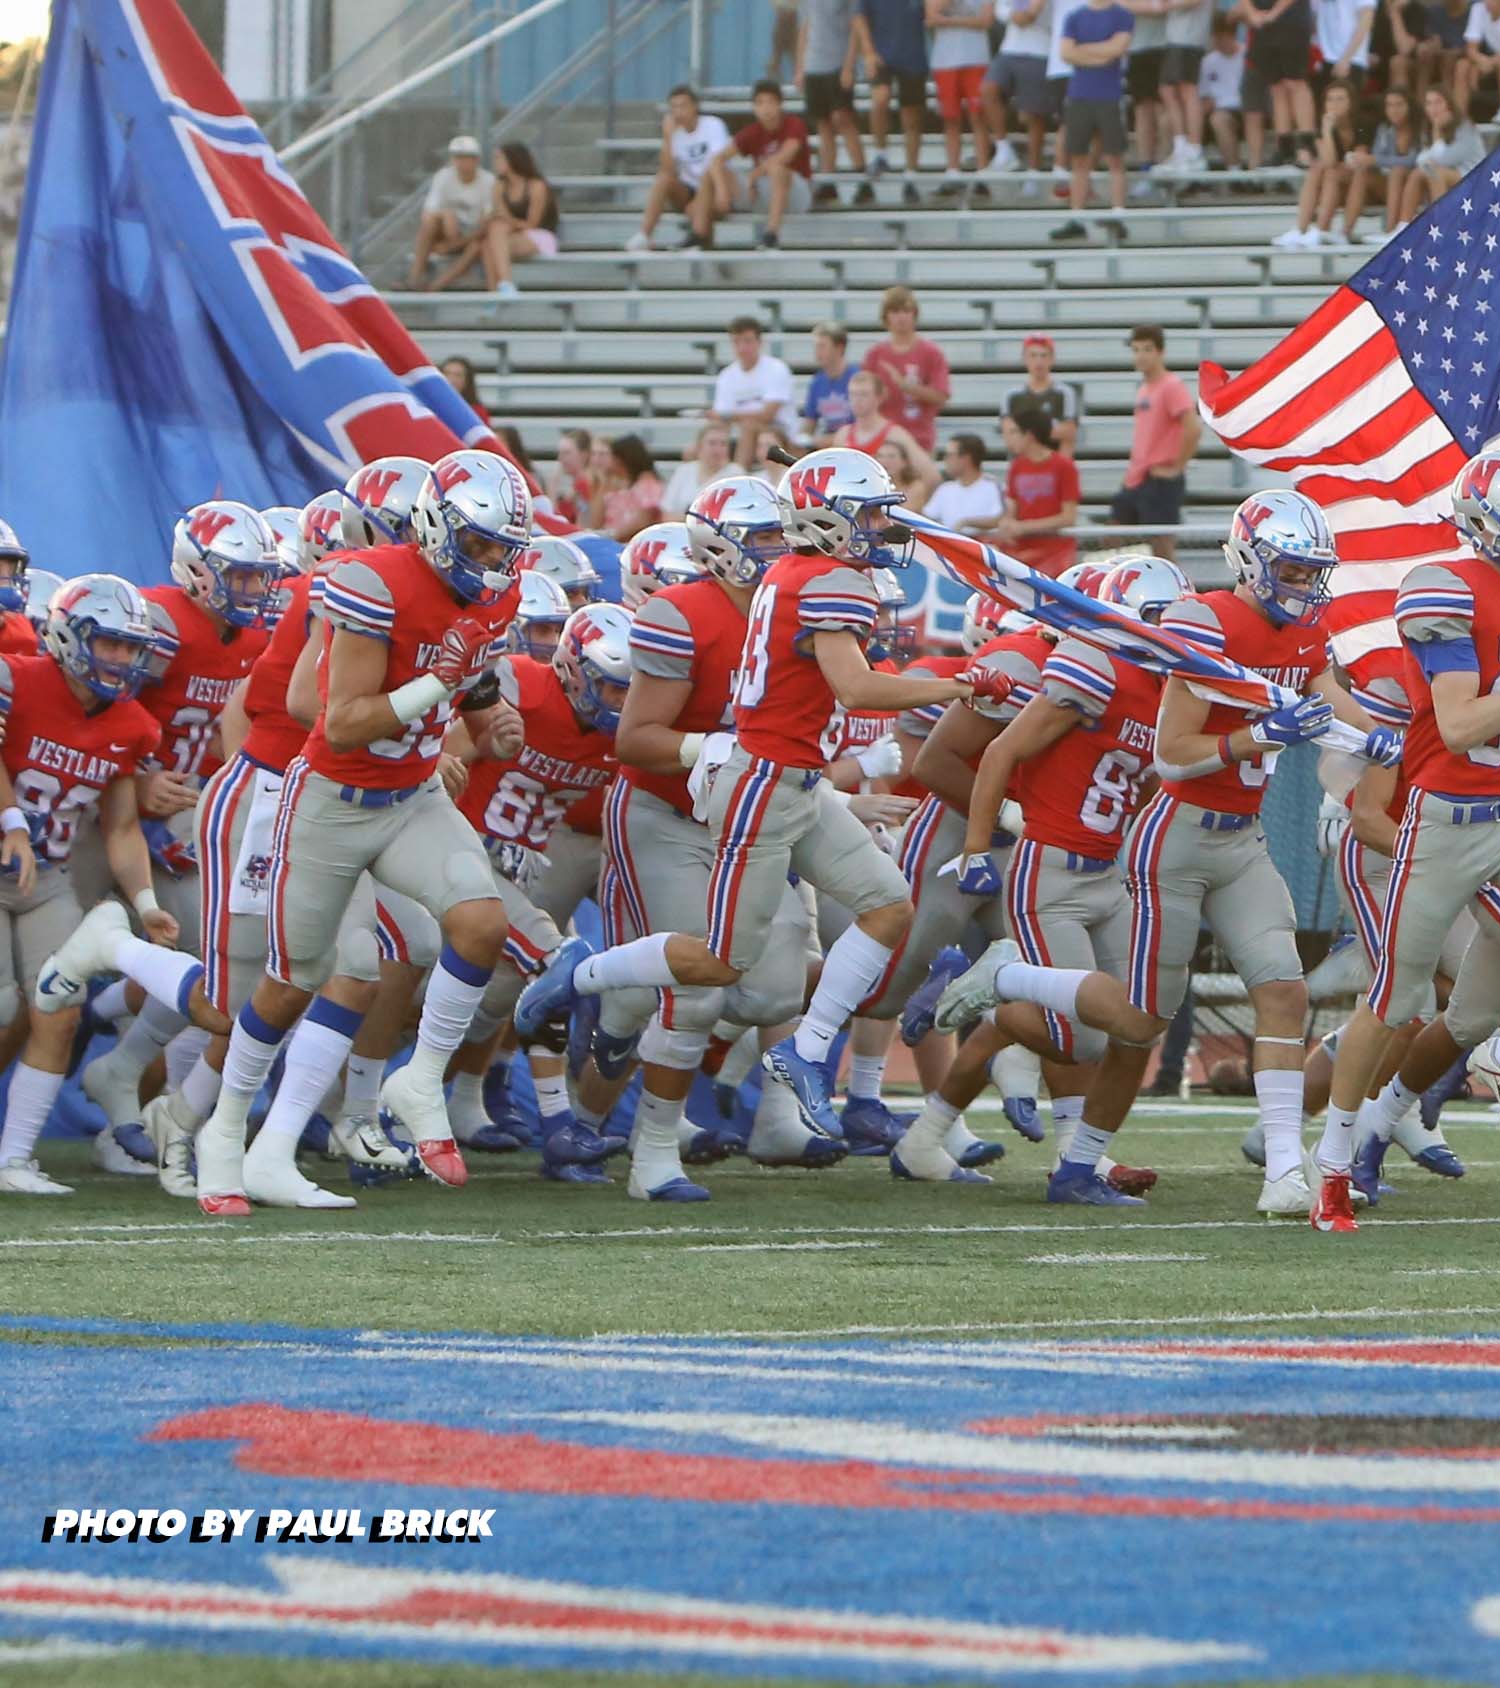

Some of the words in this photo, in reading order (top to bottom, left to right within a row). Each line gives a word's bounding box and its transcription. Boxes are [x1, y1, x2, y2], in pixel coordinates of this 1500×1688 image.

[356, 469, 402, 507] W
[696, 488, 736, 524] W
[789, 467, 836, 510] W
[189, 508, 235, 546] W
[304, 506, 341, 545] W
[629, 541, 667, 575] W
